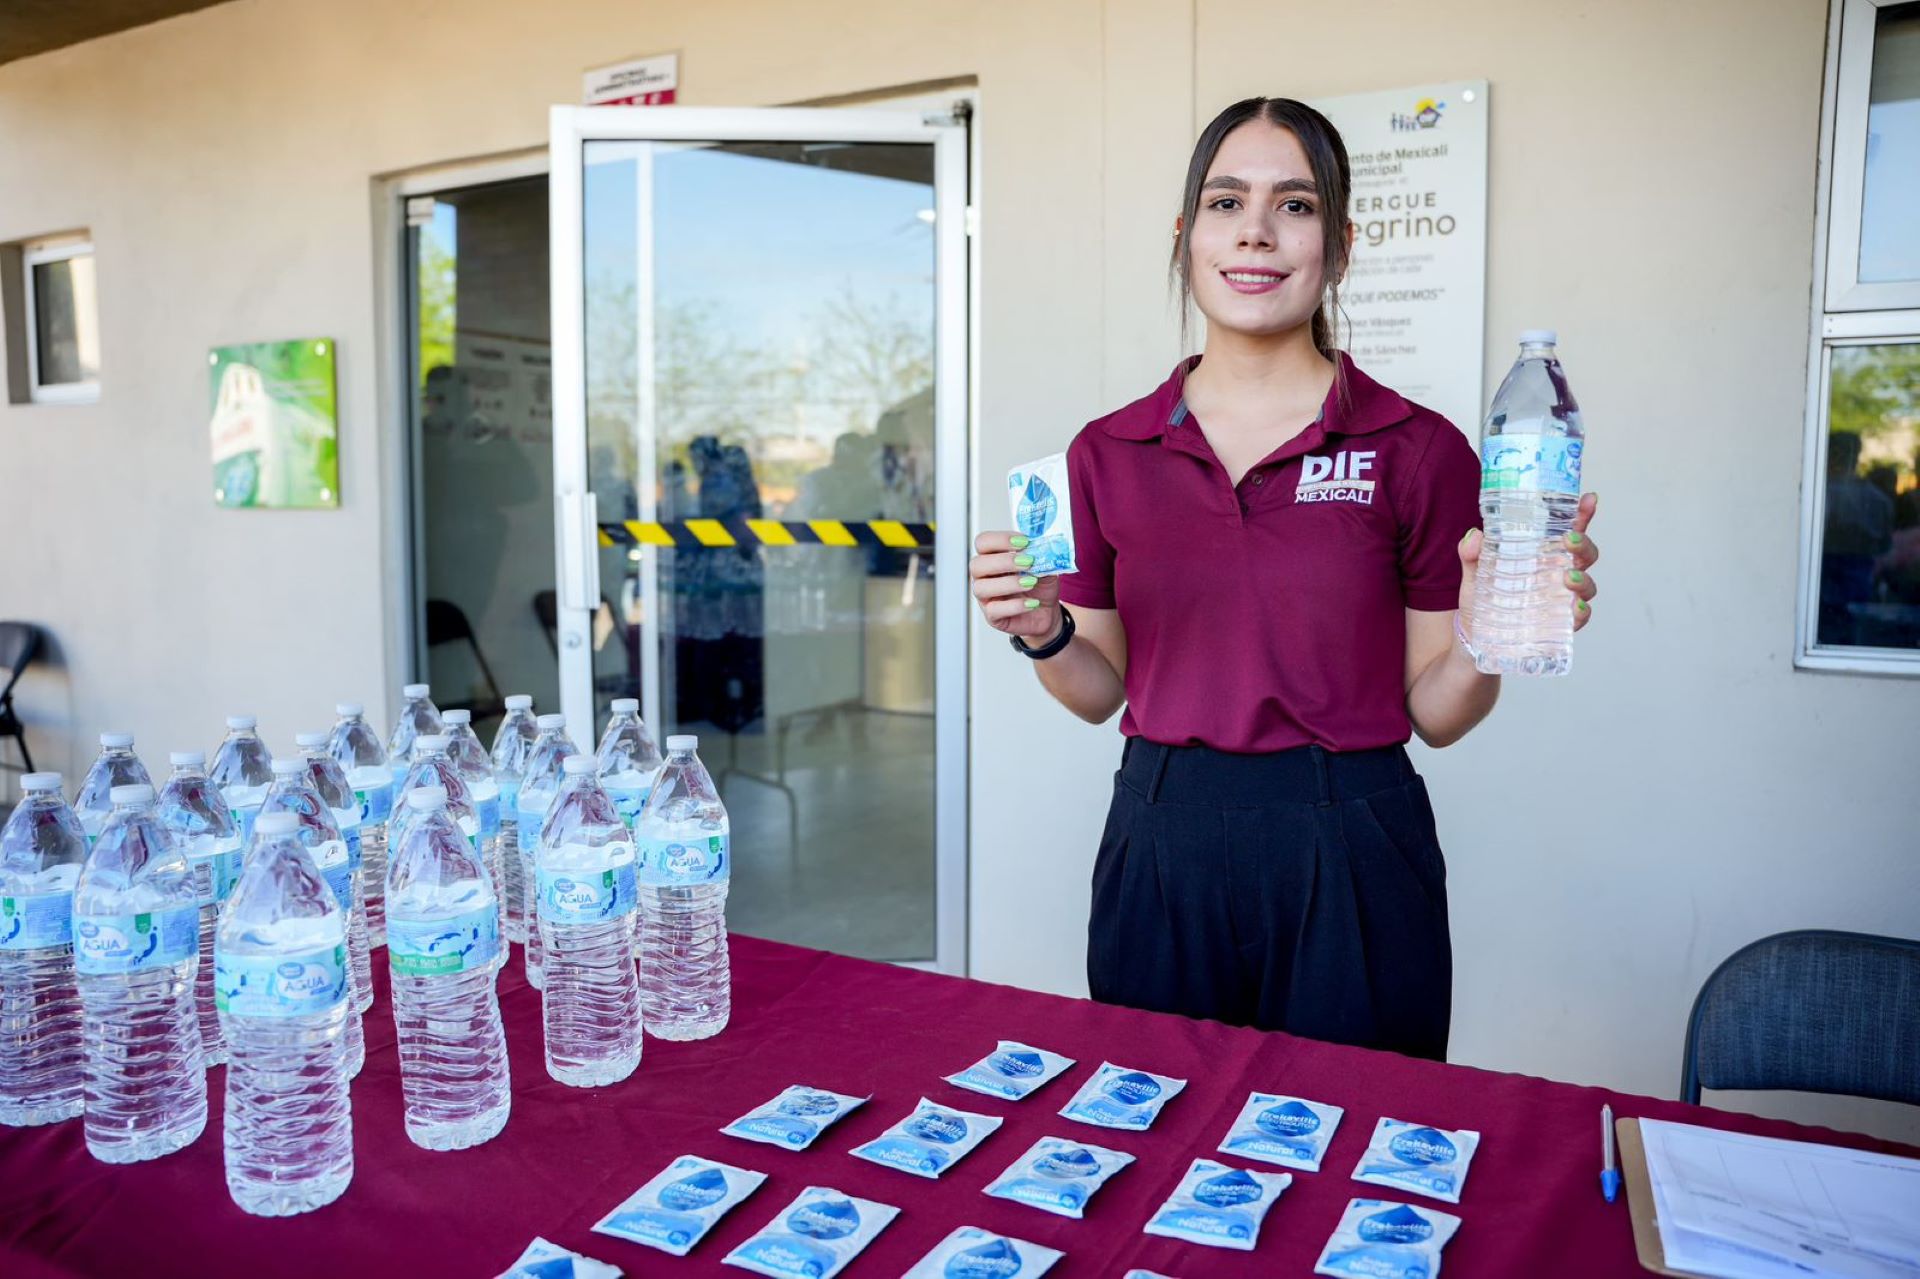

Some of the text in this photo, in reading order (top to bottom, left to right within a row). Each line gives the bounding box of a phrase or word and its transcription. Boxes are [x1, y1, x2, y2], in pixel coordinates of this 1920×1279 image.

[1376, 149, 1392, 162] de
[1395, 144, 1448, 160] Mexicali
[1351, 162, 1402, 178] unicipal
[1355, 191, 1437, 213] ERGUE
[1350, 211, 1456, 248] egrino
[1298, 450, 1377, 486] DIF
[1294, 489, 1373, 505] MEXICALI
[670, 857, 701, 867] AGUA
[560, 893, 593, 904] AGUA
[83, 939, 121, 951] AGUA
[284, 975, 326, 992] AGUA
[1249, 1140, 1295, 1156] Natural
